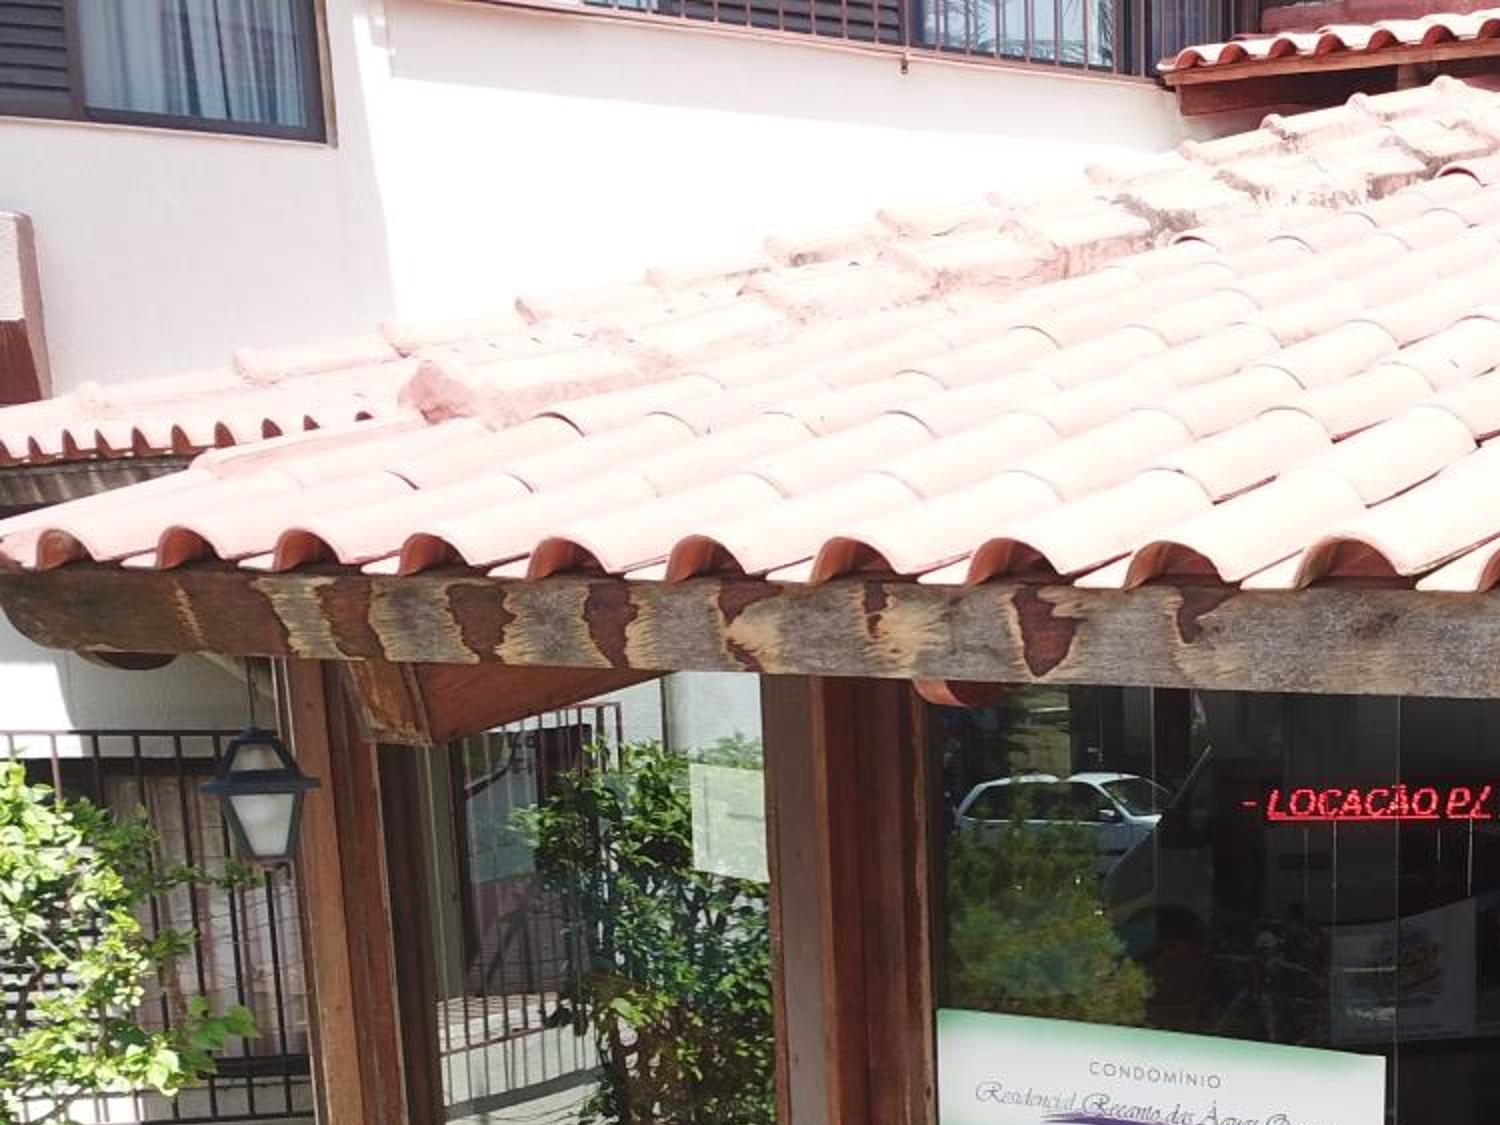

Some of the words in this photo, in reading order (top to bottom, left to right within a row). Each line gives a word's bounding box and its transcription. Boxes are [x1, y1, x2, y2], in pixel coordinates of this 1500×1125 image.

[1089, 1060, 1222, 1089] CONDOMÍNIO
[975, 1081, 1077, 1111] Residencial
[1081, 1093, 1160, 1122] Recanto
[1166, 1104, 1195, 1125] das
